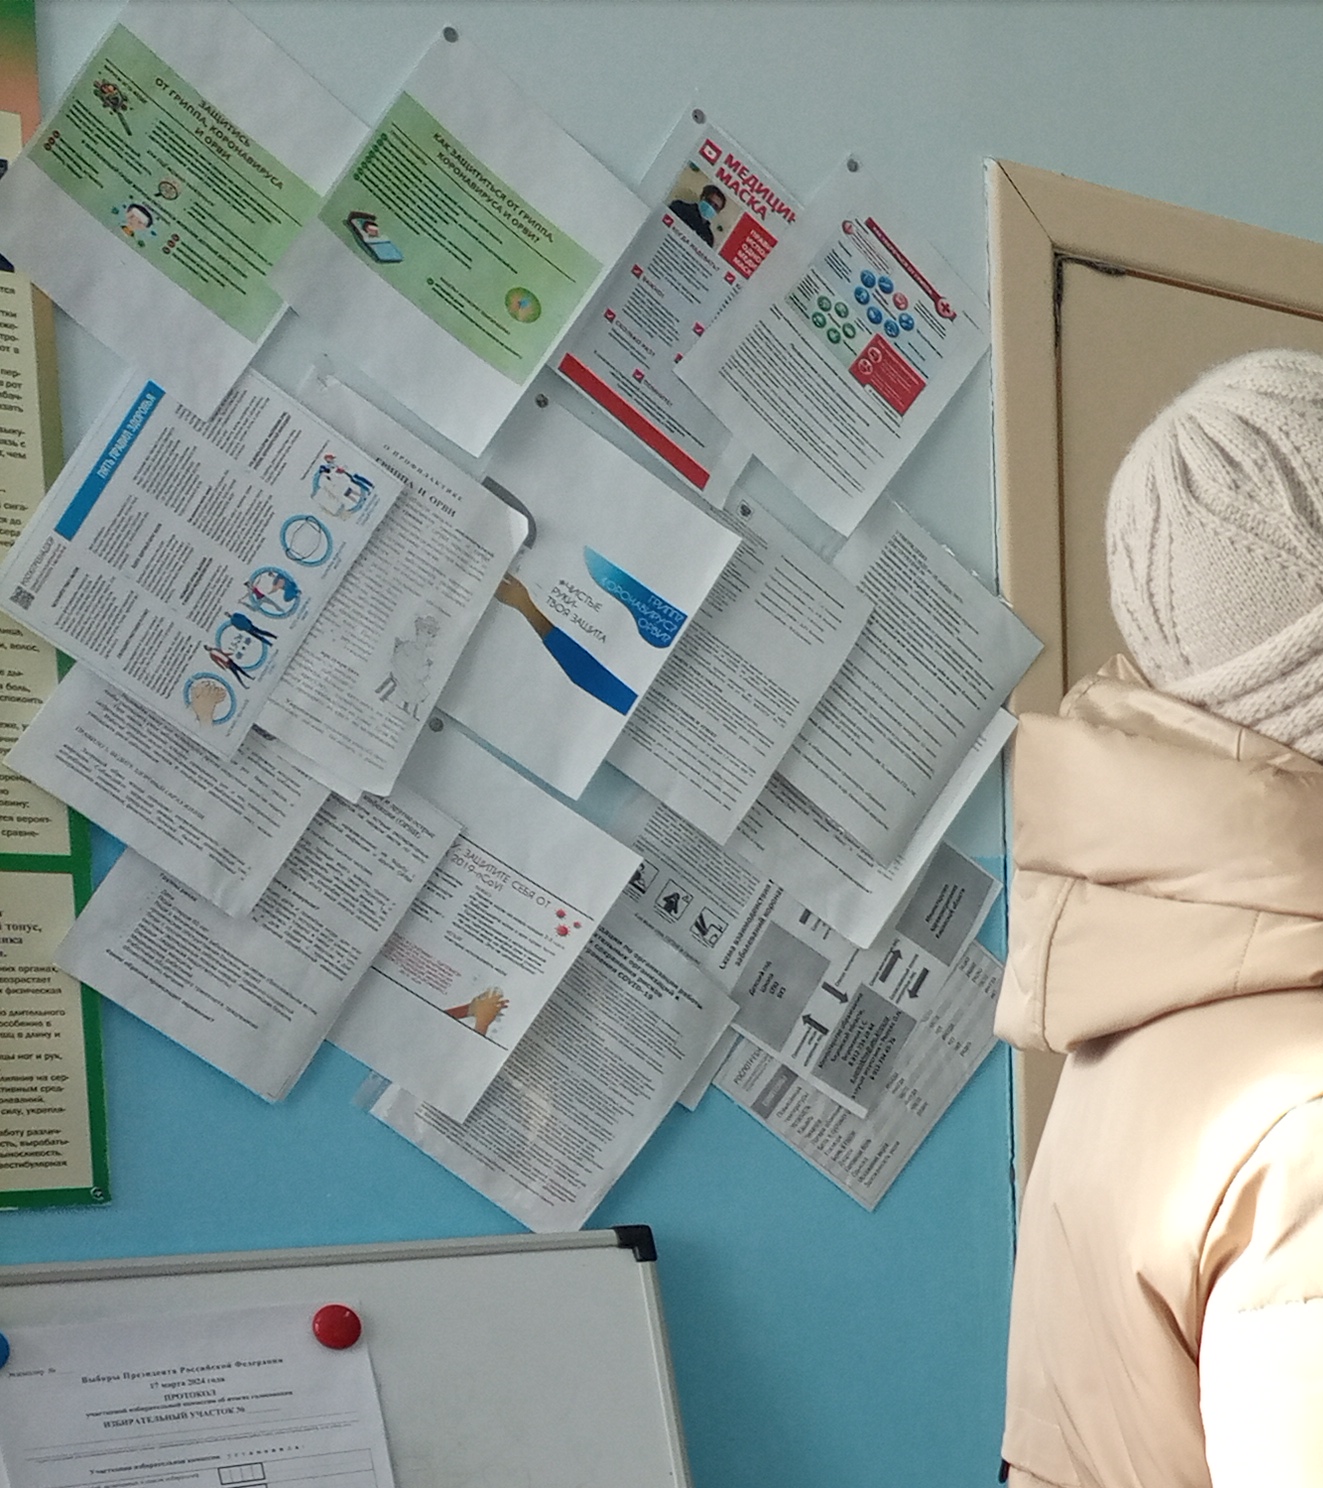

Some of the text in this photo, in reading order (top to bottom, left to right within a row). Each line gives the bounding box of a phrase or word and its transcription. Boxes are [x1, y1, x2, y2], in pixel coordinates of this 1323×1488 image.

[153, 75, 285, 191] ОТ ГРИППА, КОРОНАВИРУСА
[193, 126, 232, 162] И ОРВИ
[198, 99, 252, 148] ЗАЩИТИСЬ
[431, 131, 556, 244] КАК ЗАЩИТИТЬСЯ ОТ ГРИППА,
[435, 151, 540, 245] КОРОНАВИРУСА И ОРВИ?
[713, 166, 771, 220] МАСКА
[96, 392, 157, 479] ПЯТЬ ПРАВИЛ ЗДОРОВЬЯ
[391, 449, 464, 502] ПРОФИЛАКТИКЕ
[427, 494, 457, 517] ОРВИ
[544, 595, 608, 643] ТВОЯ ЗАЩИТА
[636, 616, 671, 644] ОРВИ?
[647, 594, 684, 623] ГРИПП?
[462, 848, 551, 910] ЗАЩИТИТЕ СЕБЯ ОТ
[6, 923, 42, 933] тонус,
[717, 882, 773, 971] Схема взаимодействия
[732, 916, 767, 967] заболеваний
[616, 970, 654, 1001] COVID-19
[80, 1373, 121, 1385] Выборы
[122, 1367, 177, 1381] Президента
[179, 1362, 232, 1375] Российской
[163, 1388, 217, 1402] ПРОТОКОЛ
[103, 1412, 189, 1430] ИЗБИРАТЕЛЬНЫЙ
[189, 1407, 235, 1421] УЧАСТОК
